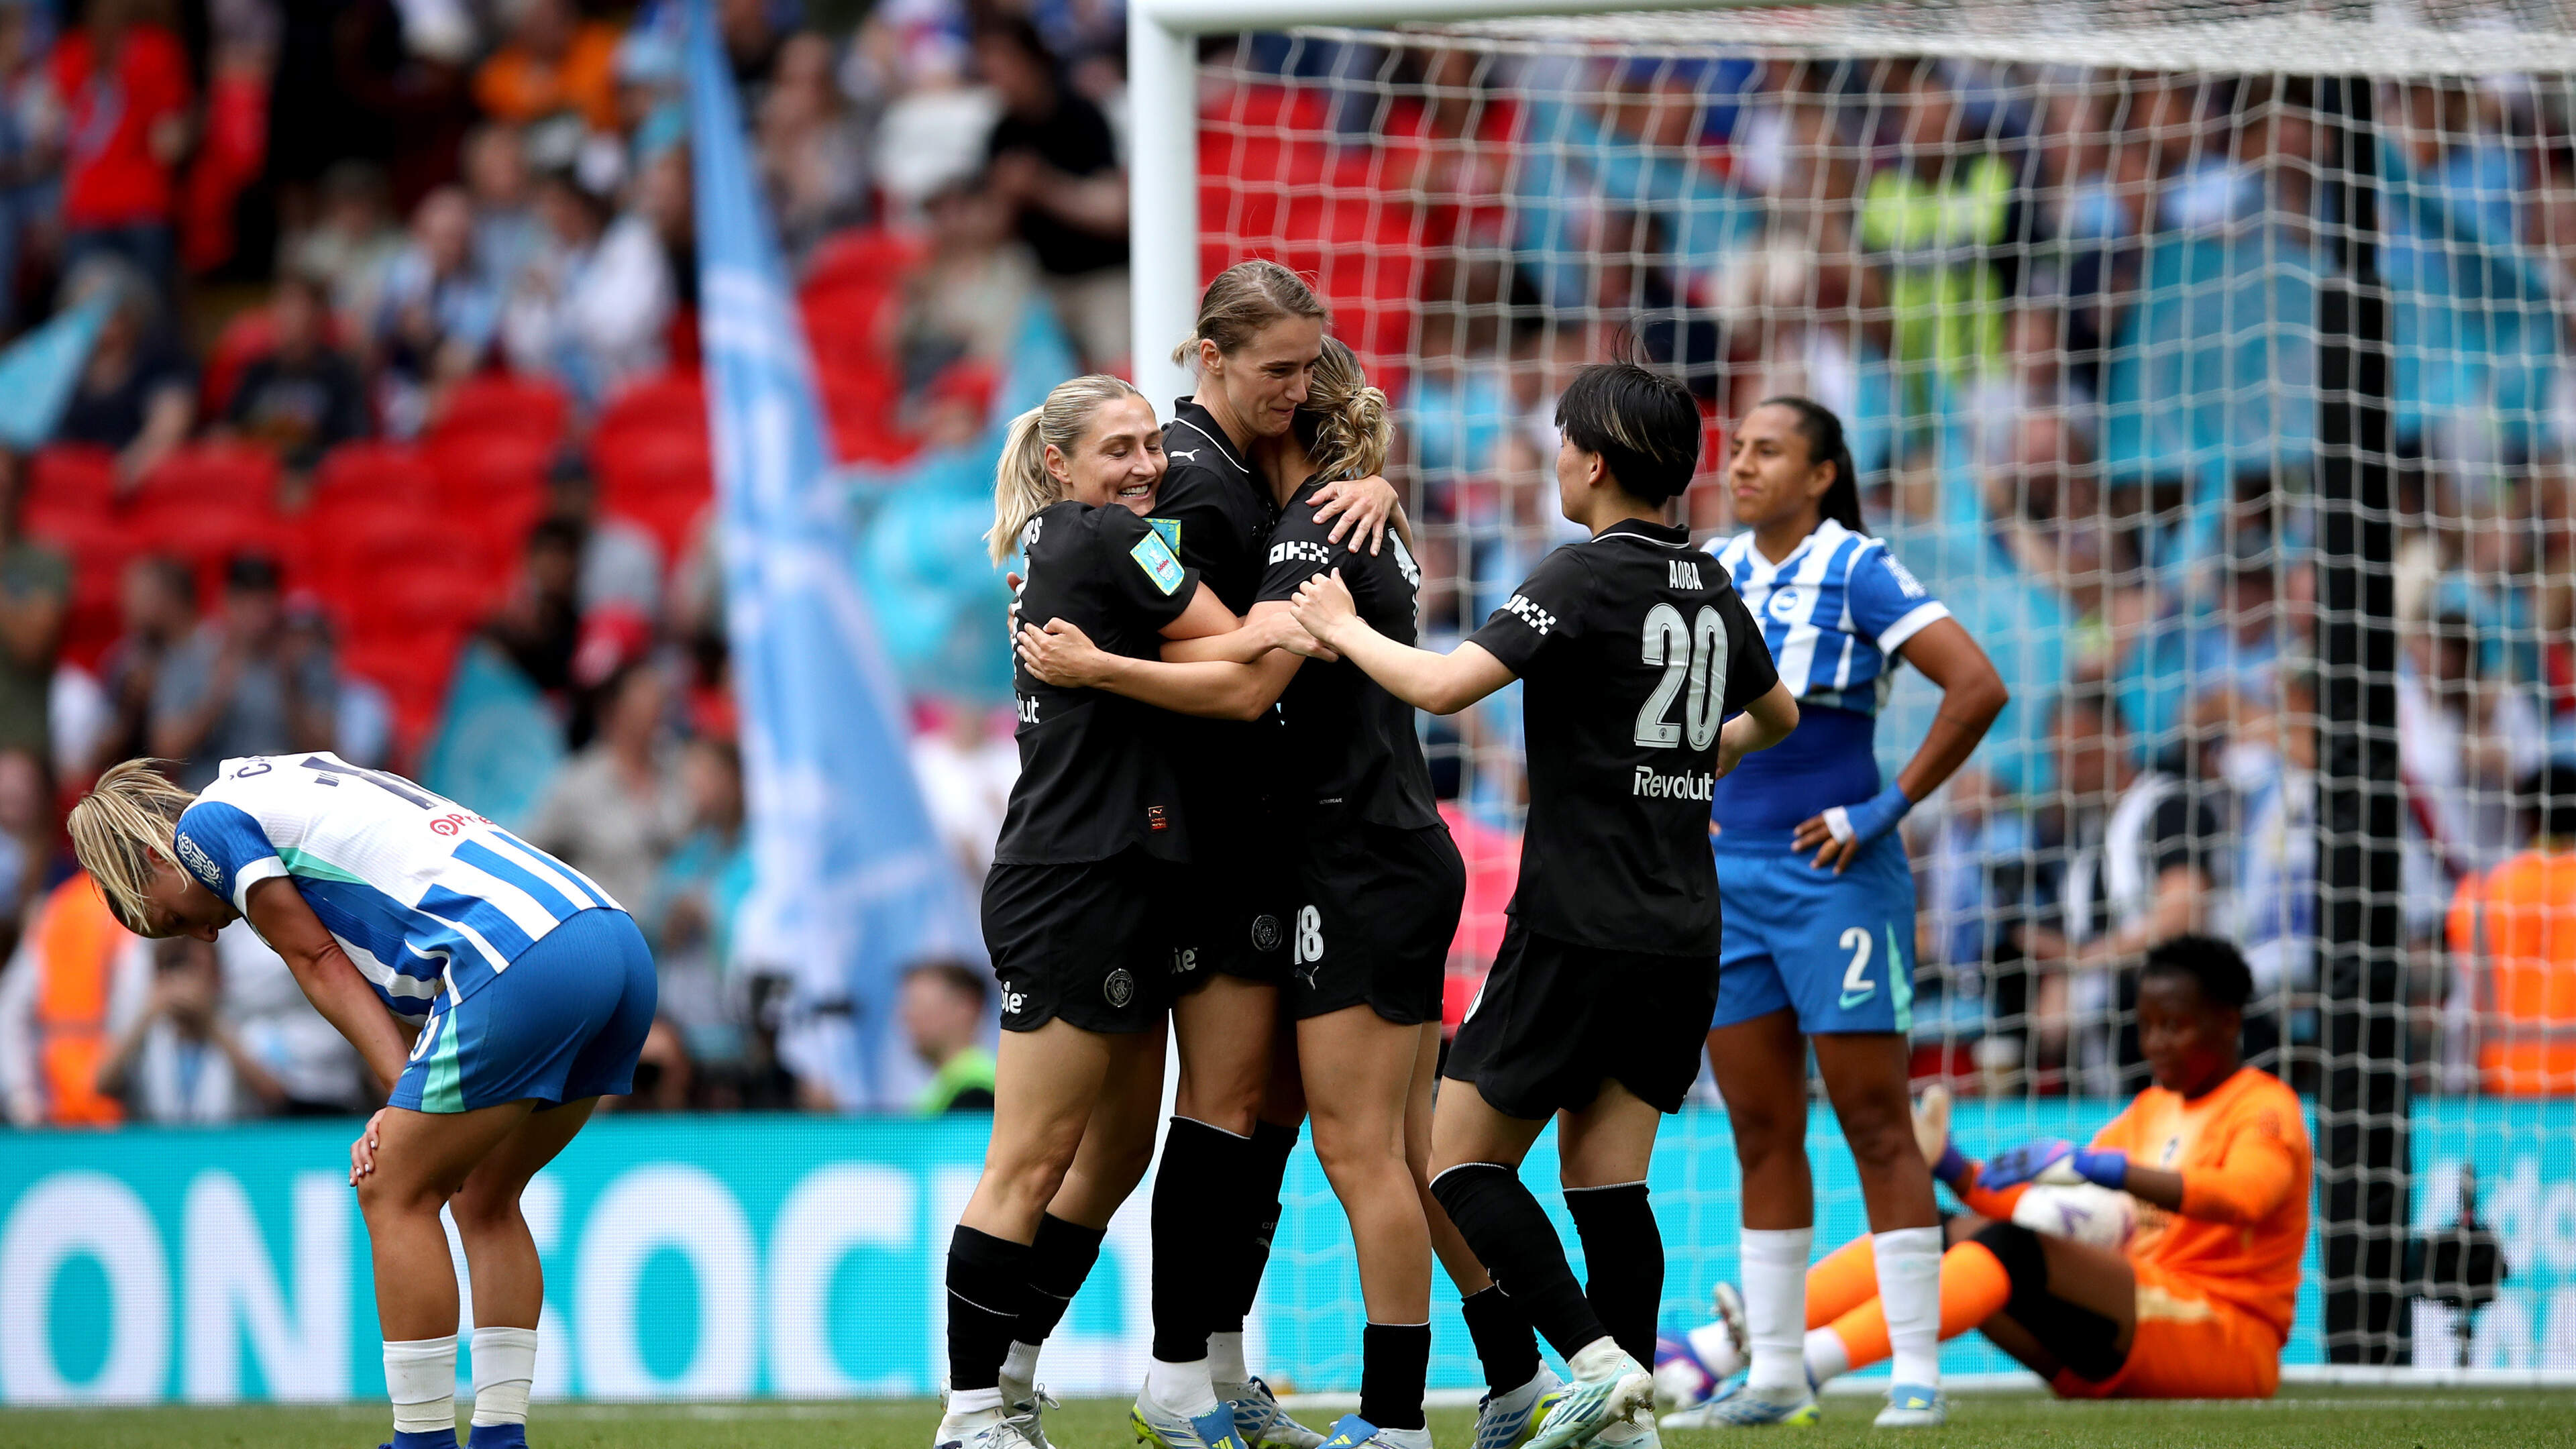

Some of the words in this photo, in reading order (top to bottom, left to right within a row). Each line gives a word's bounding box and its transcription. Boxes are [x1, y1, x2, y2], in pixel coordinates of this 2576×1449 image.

[1269, 541, 1330, 566] OKX
[1668, 559, 1703, 590] AOBA
[1634, 602, 1728, 751] 20
[1633, 765, 1714, 802] Revolut
[1839, 926, 1876, 991] 2
